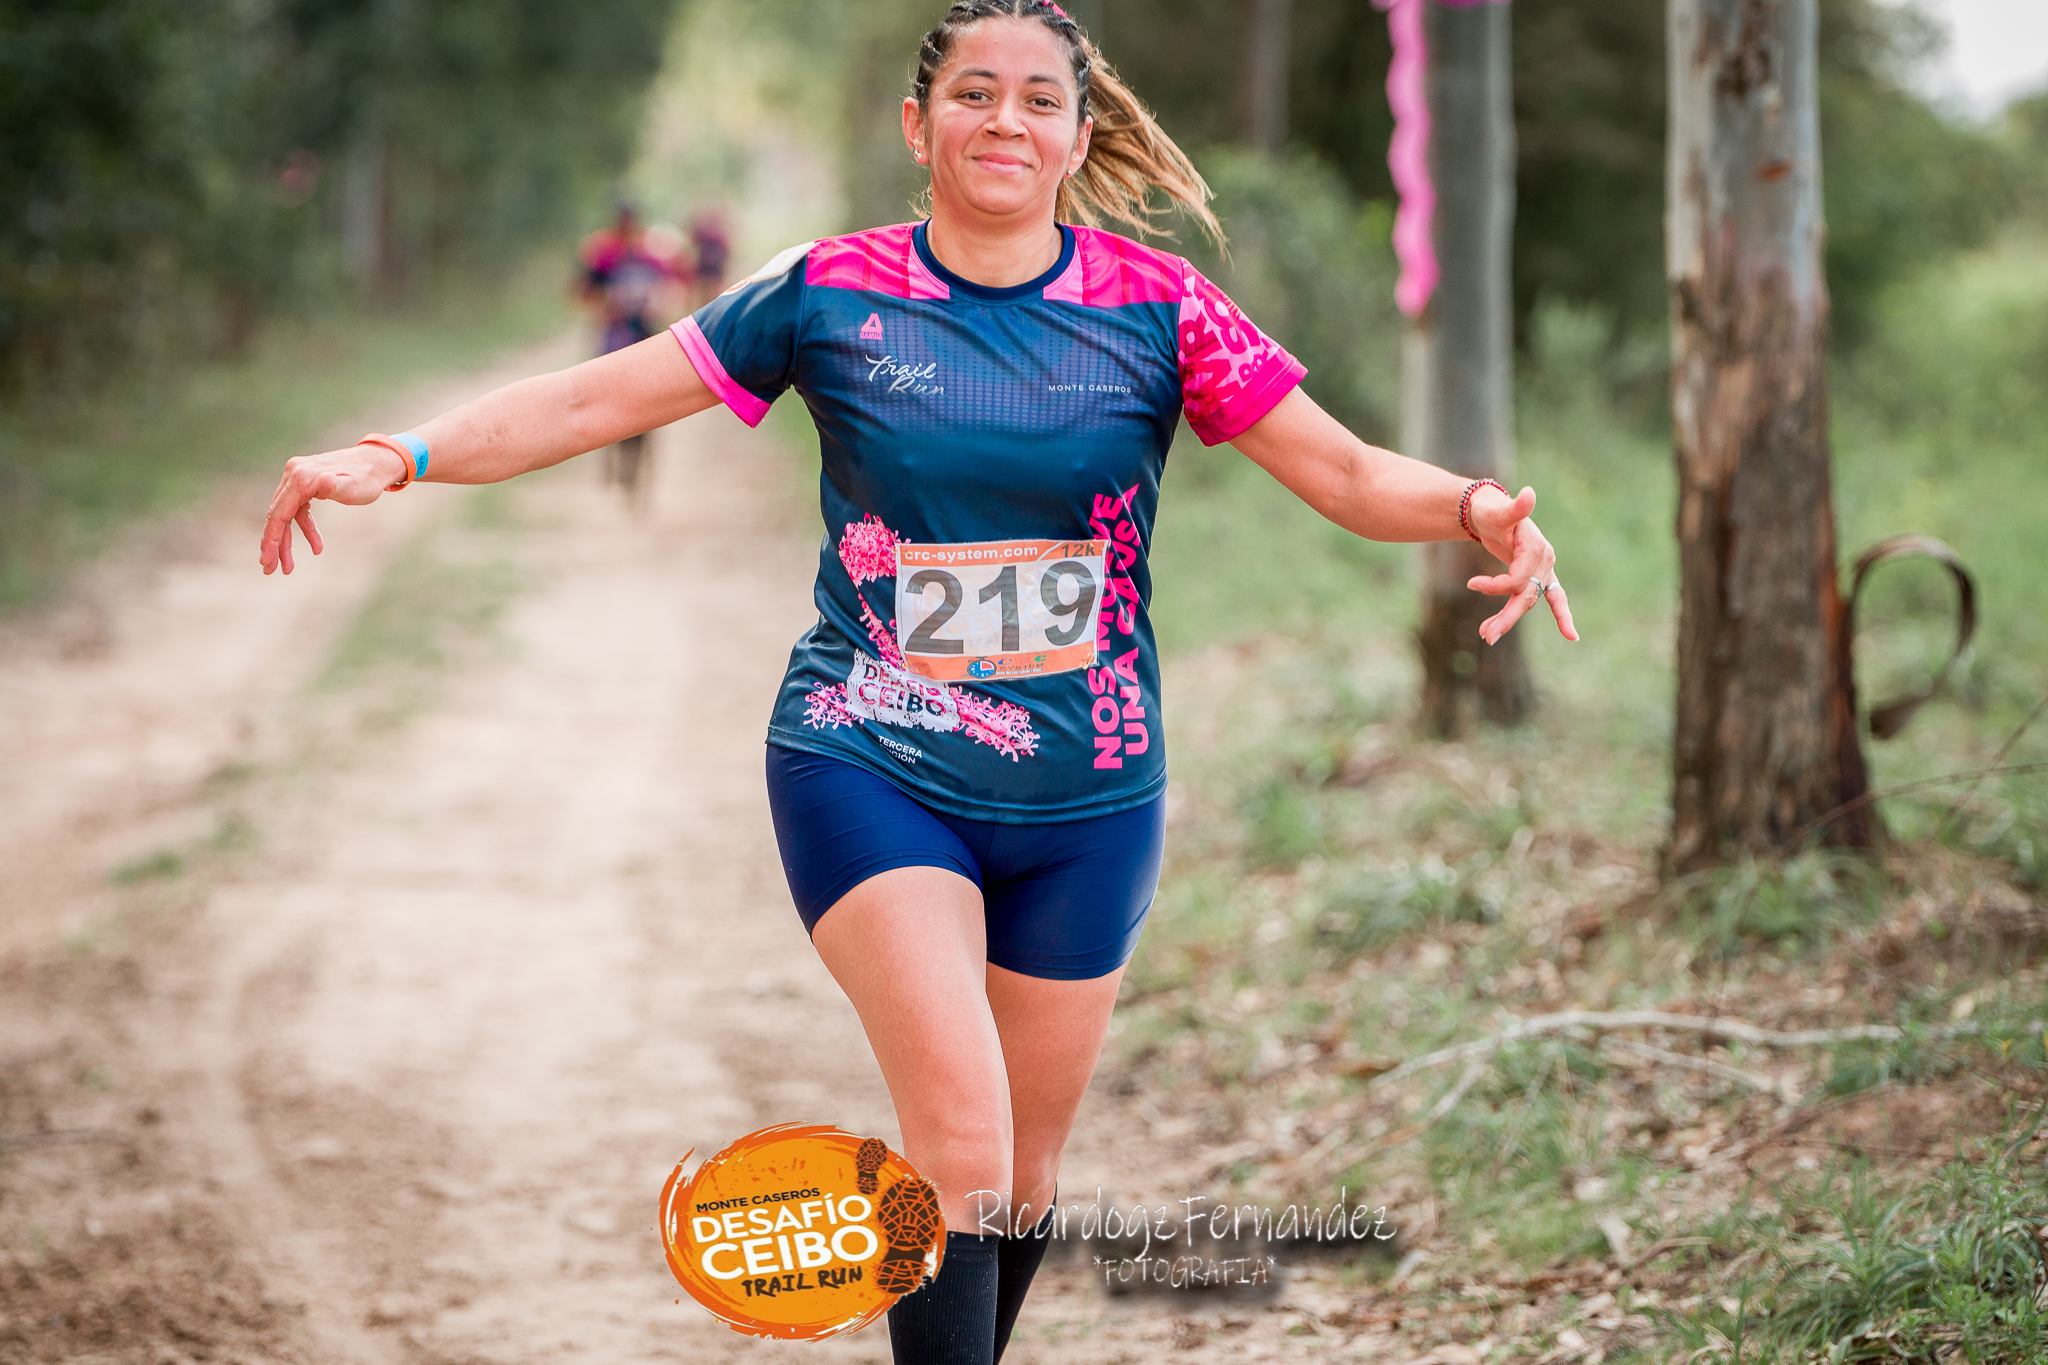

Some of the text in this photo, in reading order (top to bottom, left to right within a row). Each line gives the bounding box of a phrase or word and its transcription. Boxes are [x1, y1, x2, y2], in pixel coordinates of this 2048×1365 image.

[865, 354, 937, 382] Trail
[887, 374, 947, 397] Run
[1048, 384, 1132, 394] MONTE CASEROS
[904, 545, 1039, 564] crc-system.com
[905, 560, 1097, 655] 219
[859, 682, 946, 716] CEIBO
[1113, 646, 1149, 756] UNA
[1087, 666, 1123, 769] NOS
[878, 734, 923, 758] TERCERA
